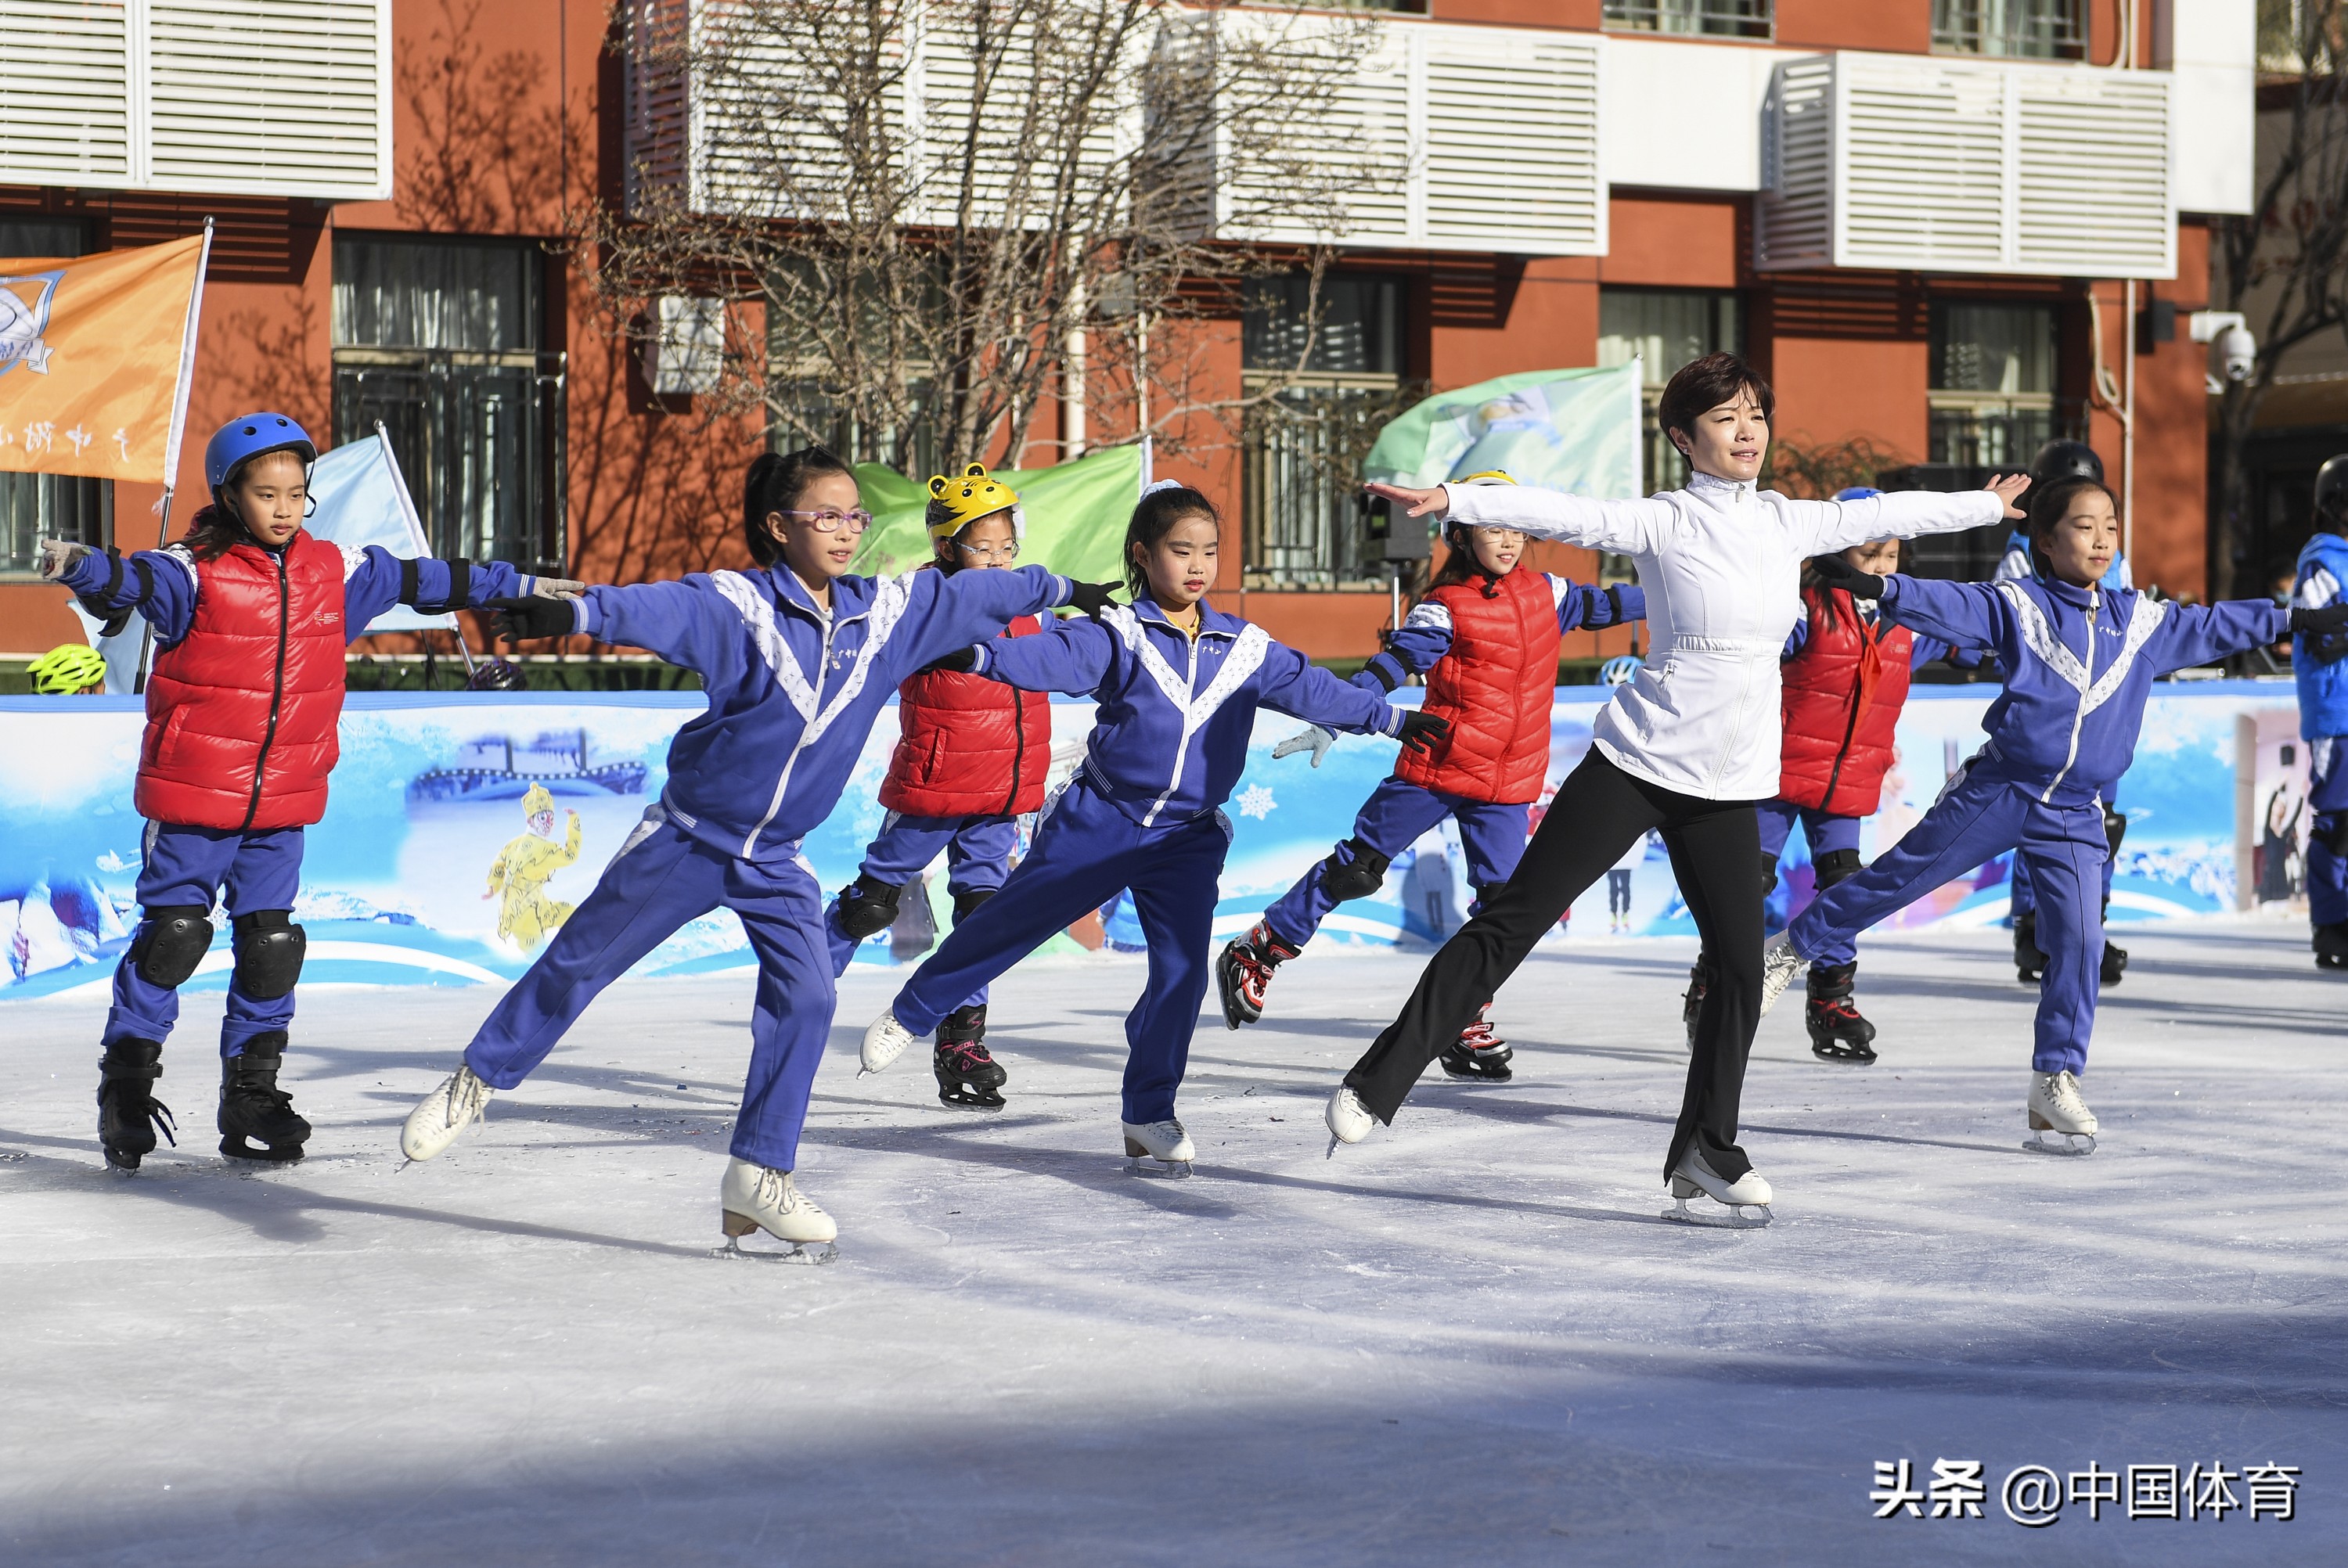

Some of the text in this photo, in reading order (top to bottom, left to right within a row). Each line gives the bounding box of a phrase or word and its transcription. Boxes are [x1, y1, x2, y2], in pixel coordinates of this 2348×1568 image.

[875, 634, 886, 647] FX
[1251, 638, 1260, 649] FX
[1249, 652, 1259, 664] FX
[2058, 654, 2069, 665] FX
[853, 673, 863, 687] FX
[1164, 675, 1174, 687] FX
